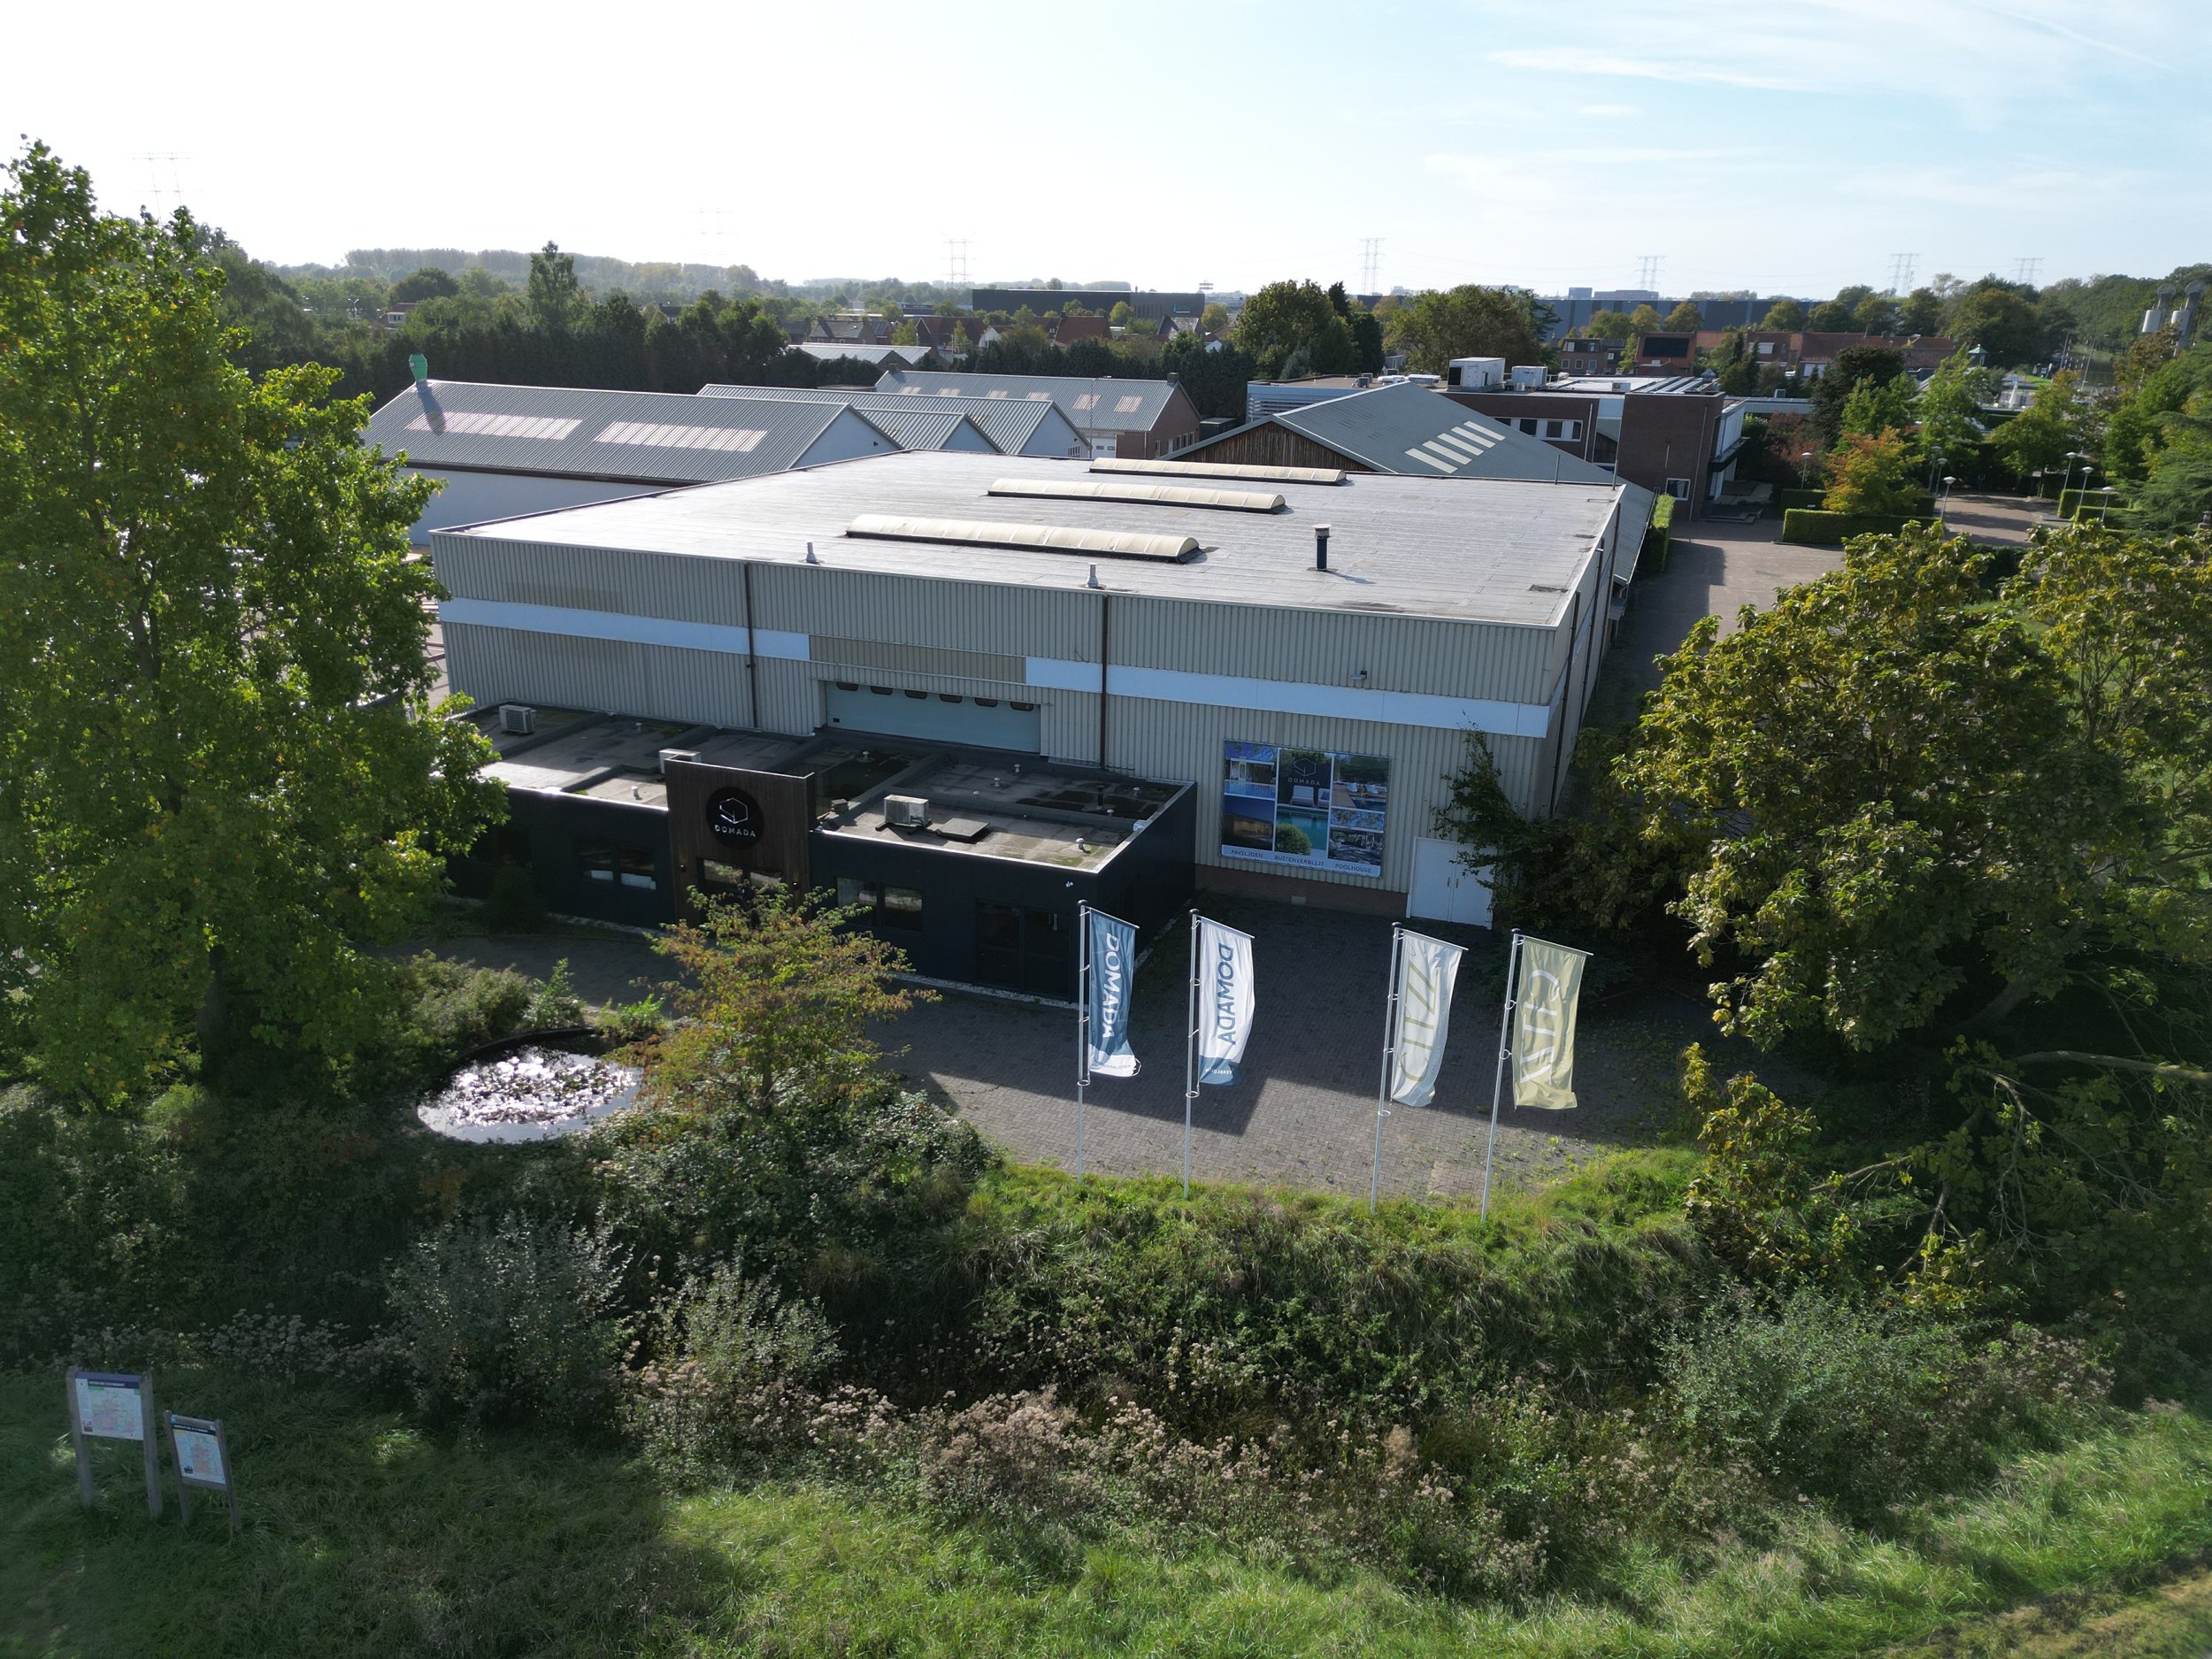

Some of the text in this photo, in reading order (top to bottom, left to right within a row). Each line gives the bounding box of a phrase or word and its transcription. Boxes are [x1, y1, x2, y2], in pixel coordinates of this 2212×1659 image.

[1287, 777, 1321, 786] DOMADA
[714, 825, 757, 837] DOMADA
[1231, 849, 1371, 873] PAVILJOEN BUITENVERBLIJF POOLHOUSE
[1102, 933, 1122, 1039] DOMADA
